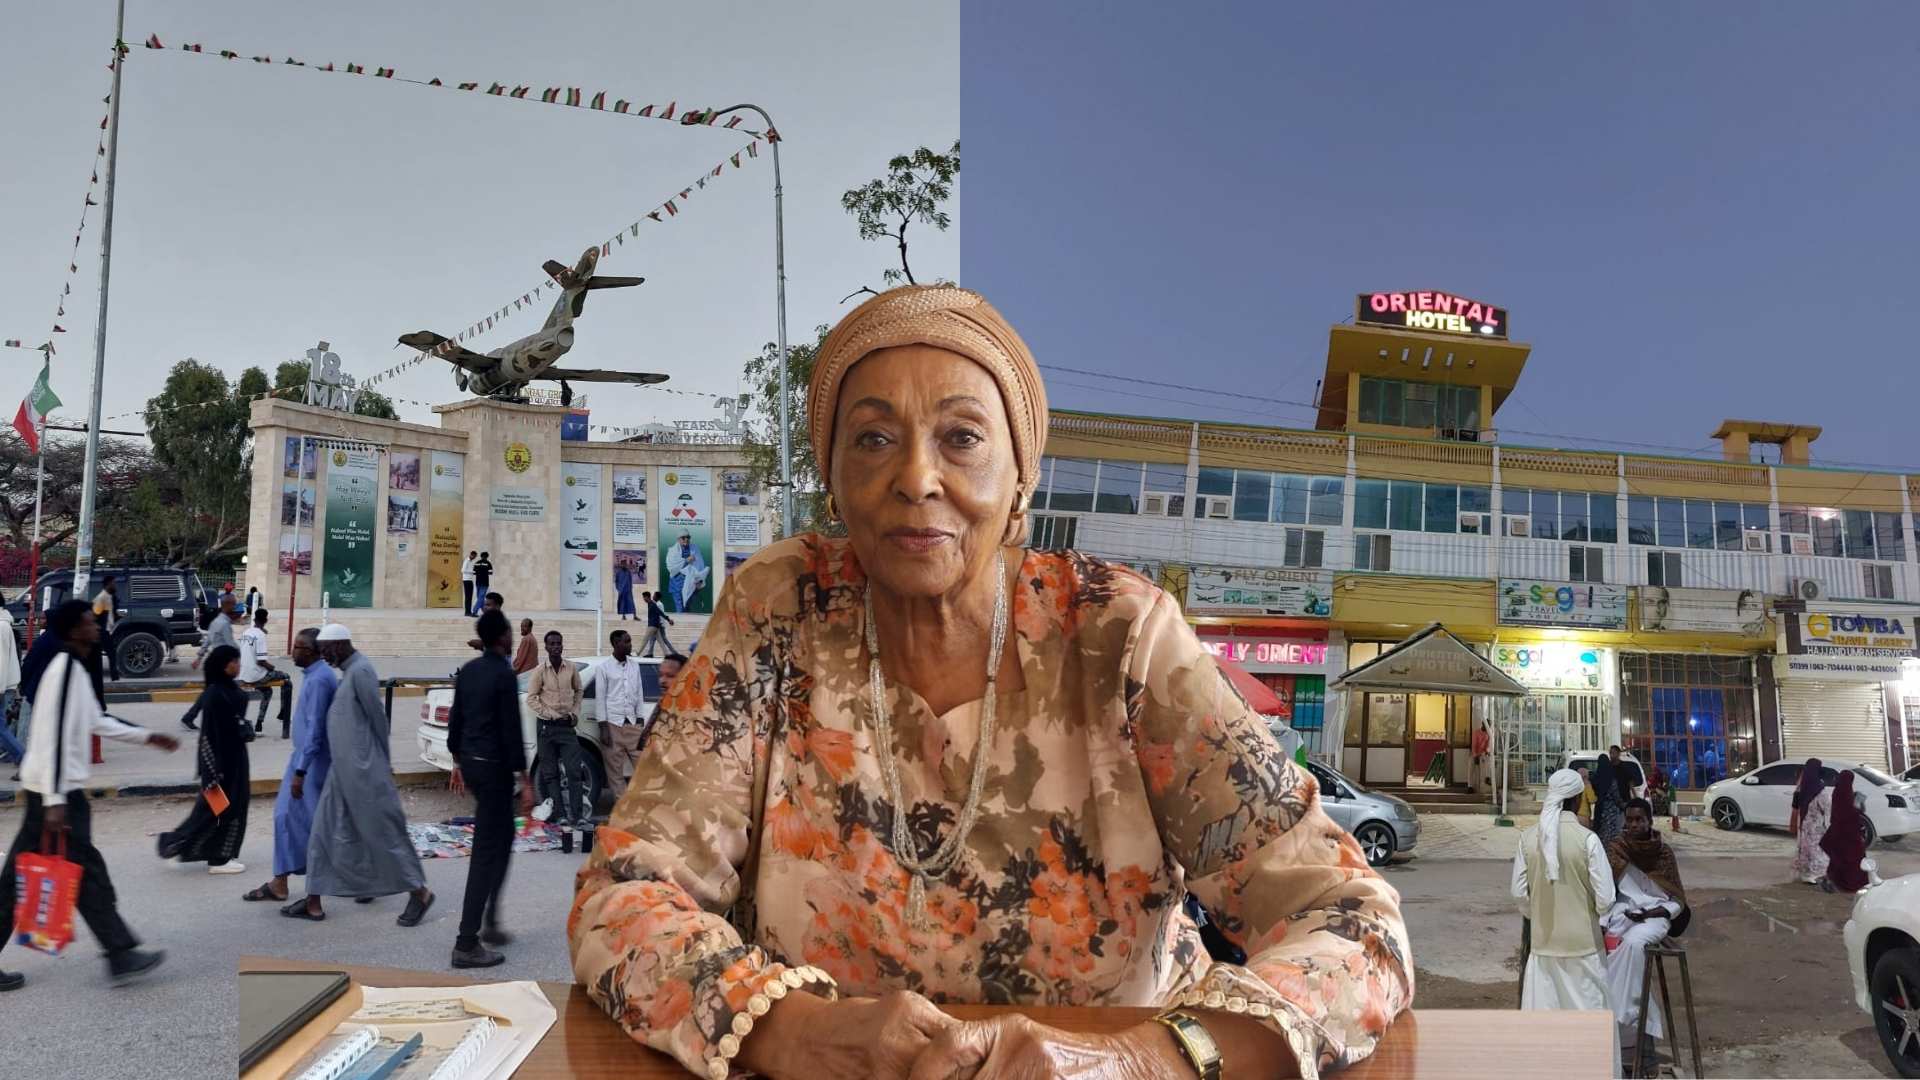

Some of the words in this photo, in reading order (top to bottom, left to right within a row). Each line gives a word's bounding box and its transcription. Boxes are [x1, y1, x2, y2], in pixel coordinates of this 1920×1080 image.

[1370, 290, 1499, 326] ORIENTAL
[1405, 310, 1472, 333] HOTEL
[308, 381, 364, 413] MAY
[673, 420, 716, 431] YEARS
[1234, 569, 1258, 581] FLY
[1264, 570, 1321, 583] ORIENT
[1828, 614, 1905, 635] TOWBA
[1215, 640, 1251, 662] FLY
[1256, 642, 1329, 665] ORIENT
[1807, 645, 1827, 655] HAJJ
